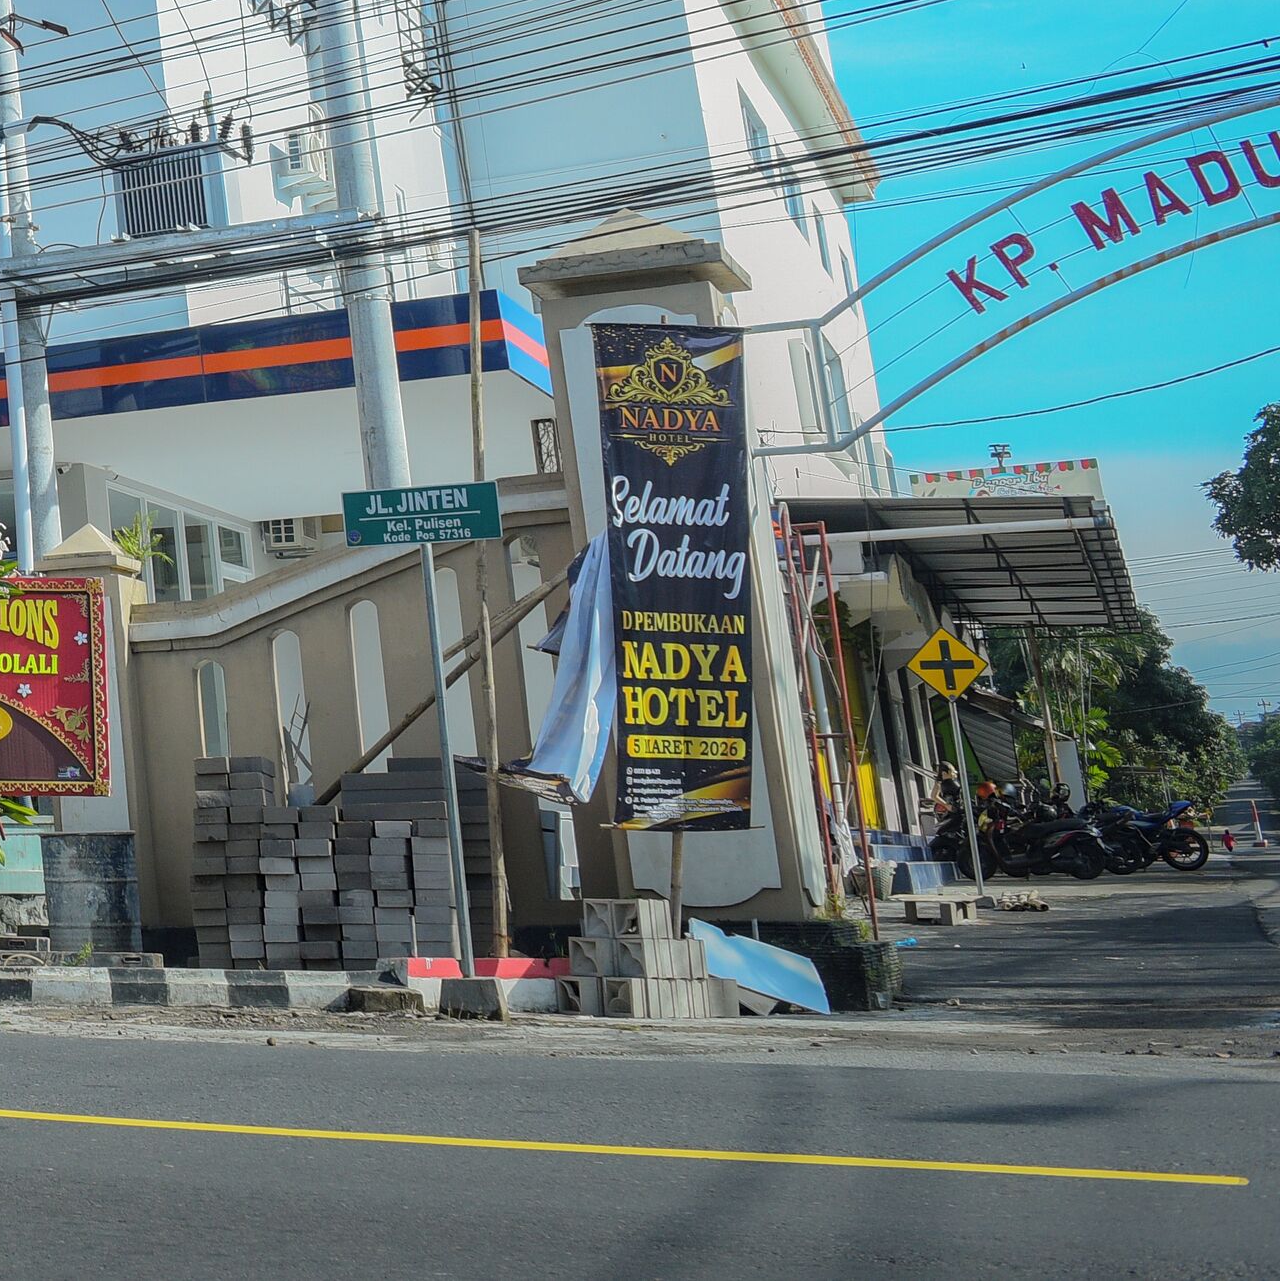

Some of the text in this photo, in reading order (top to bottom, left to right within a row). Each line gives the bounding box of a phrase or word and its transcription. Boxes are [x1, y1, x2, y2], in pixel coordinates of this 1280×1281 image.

[945, 232, 1061, 315] KP.
[659, 363, 677, 383] N
[619, 405, 721, 432] NADYA
[649, 433, 692, 443] HOTEL
[365, 487, 468, 515] JL. JINTEN
[612, 475, 730, 527] Selamat
[383, 528, 471, 542] Kode Pos 57316
[386, 518, 461, 532] Kel. Pulisen
[626, 528, 746, 599] Datang
[634, 611, 745, 634] PEMBUKAAN
[622, 640, 748, 683] NADYA
[622, 686, 748, 728] HOTEL
[633, 739, 738, 756] 5 MARET 2026
